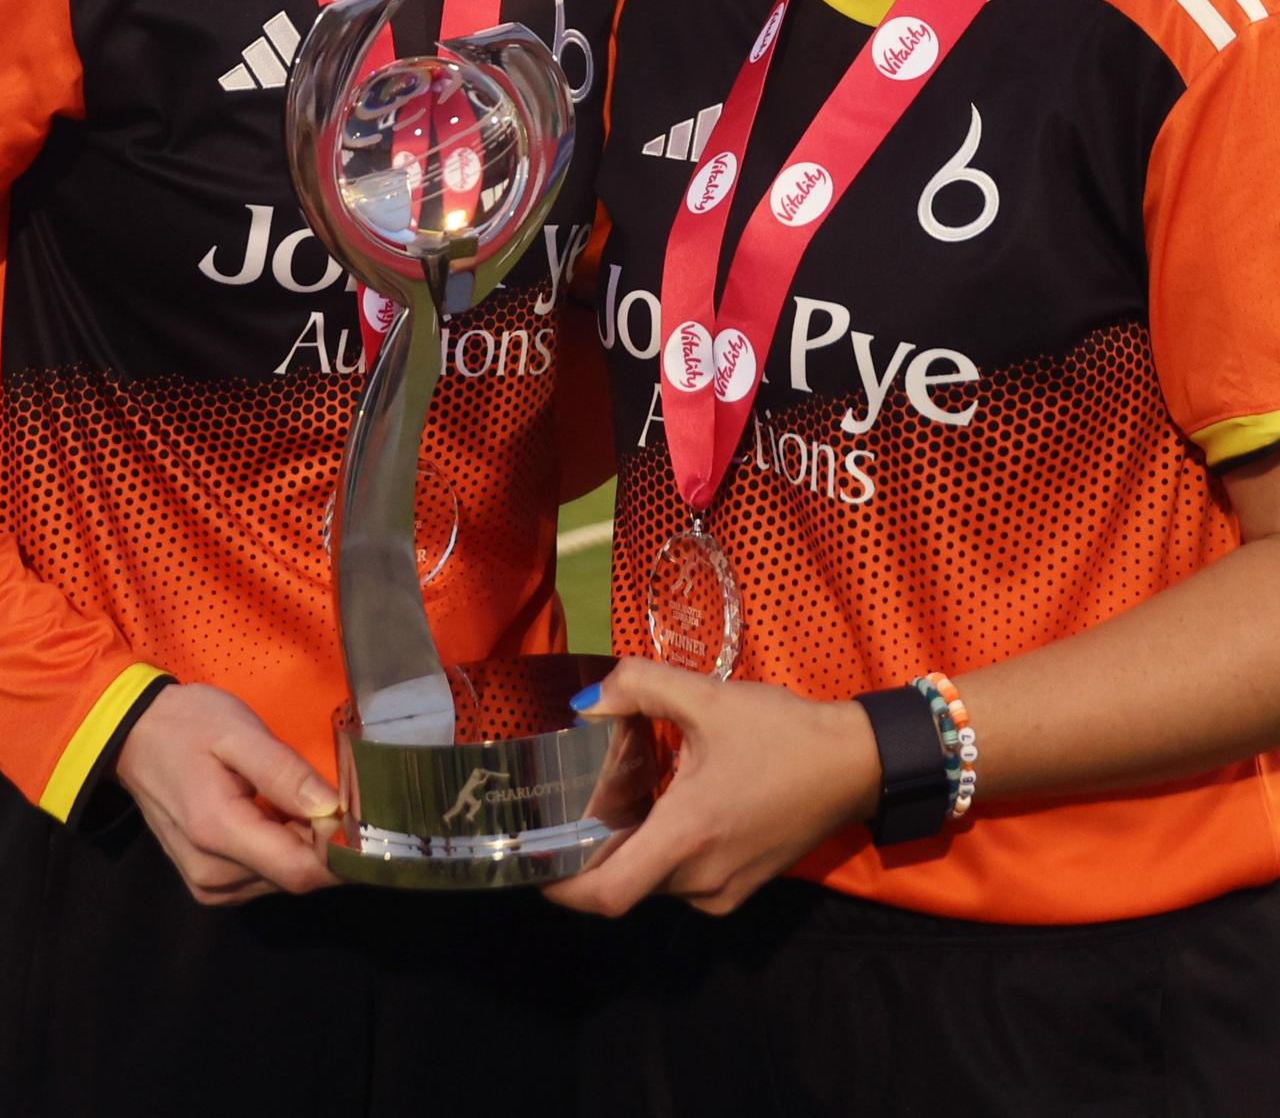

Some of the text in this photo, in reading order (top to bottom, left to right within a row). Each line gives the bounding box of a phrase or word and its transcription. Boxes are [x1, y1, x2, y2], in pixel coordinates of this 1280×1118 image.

[879, 24, 932, 76] Vitality
[694, 153, 729, 211] Vitality
[777, 168, 827, 222] Vitality
[273, 311, 554, 377] Auions
[679, 323, 705, 389] Vitality
[715, 334, 749, 398] Vitality
[790, 296, 980, 434] Pye
